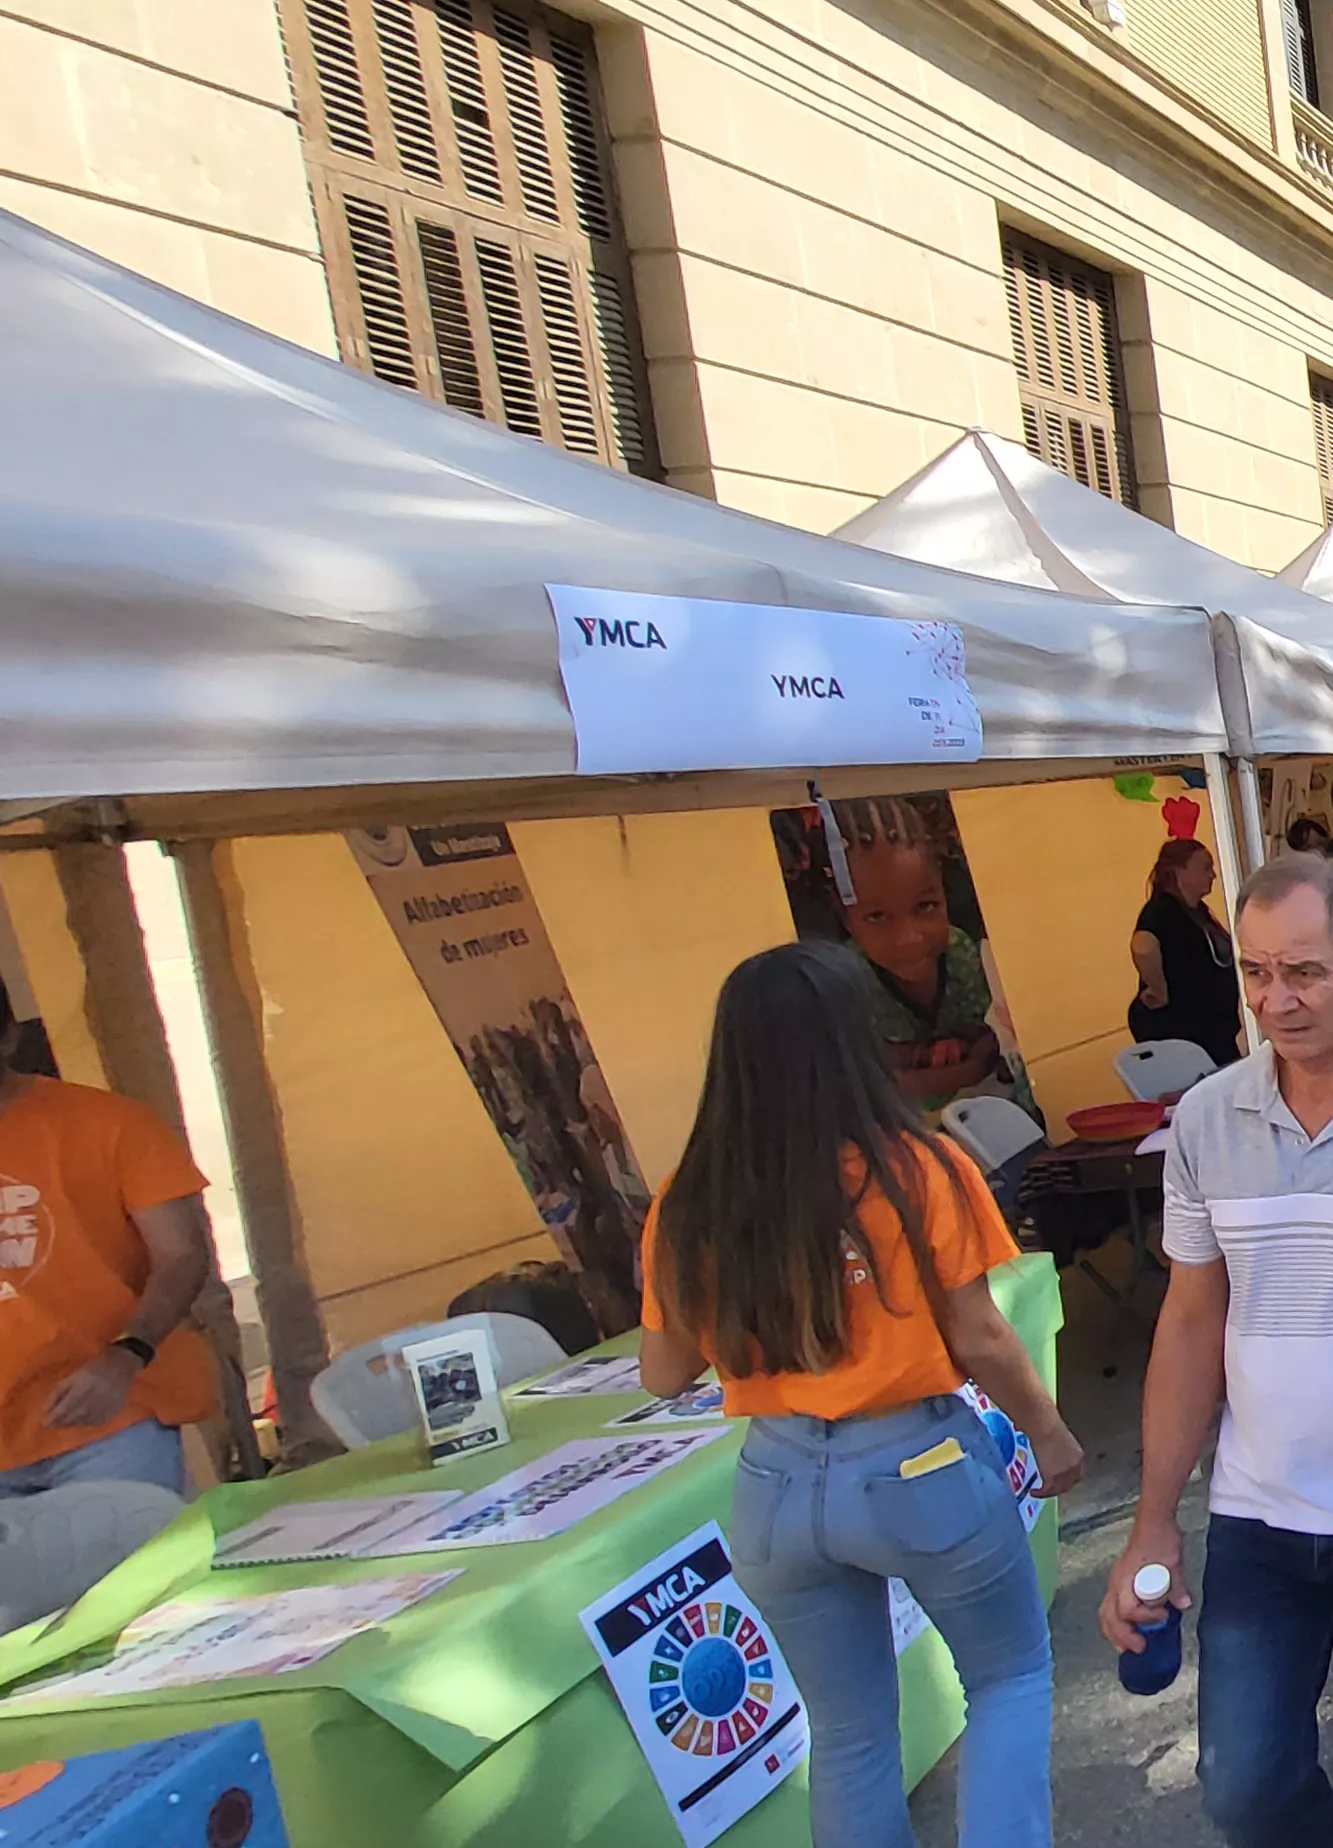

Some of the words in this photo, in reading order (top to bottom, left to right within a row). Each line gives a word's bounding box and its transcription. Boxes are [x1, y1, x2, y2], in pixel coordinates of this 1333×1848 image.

[574, 616, 667, 650] YMCA
[771, 674, 845, 700] YMCA
[440, 938, 462, 963] de
[627, 1565, 706, 1627] YMCA
